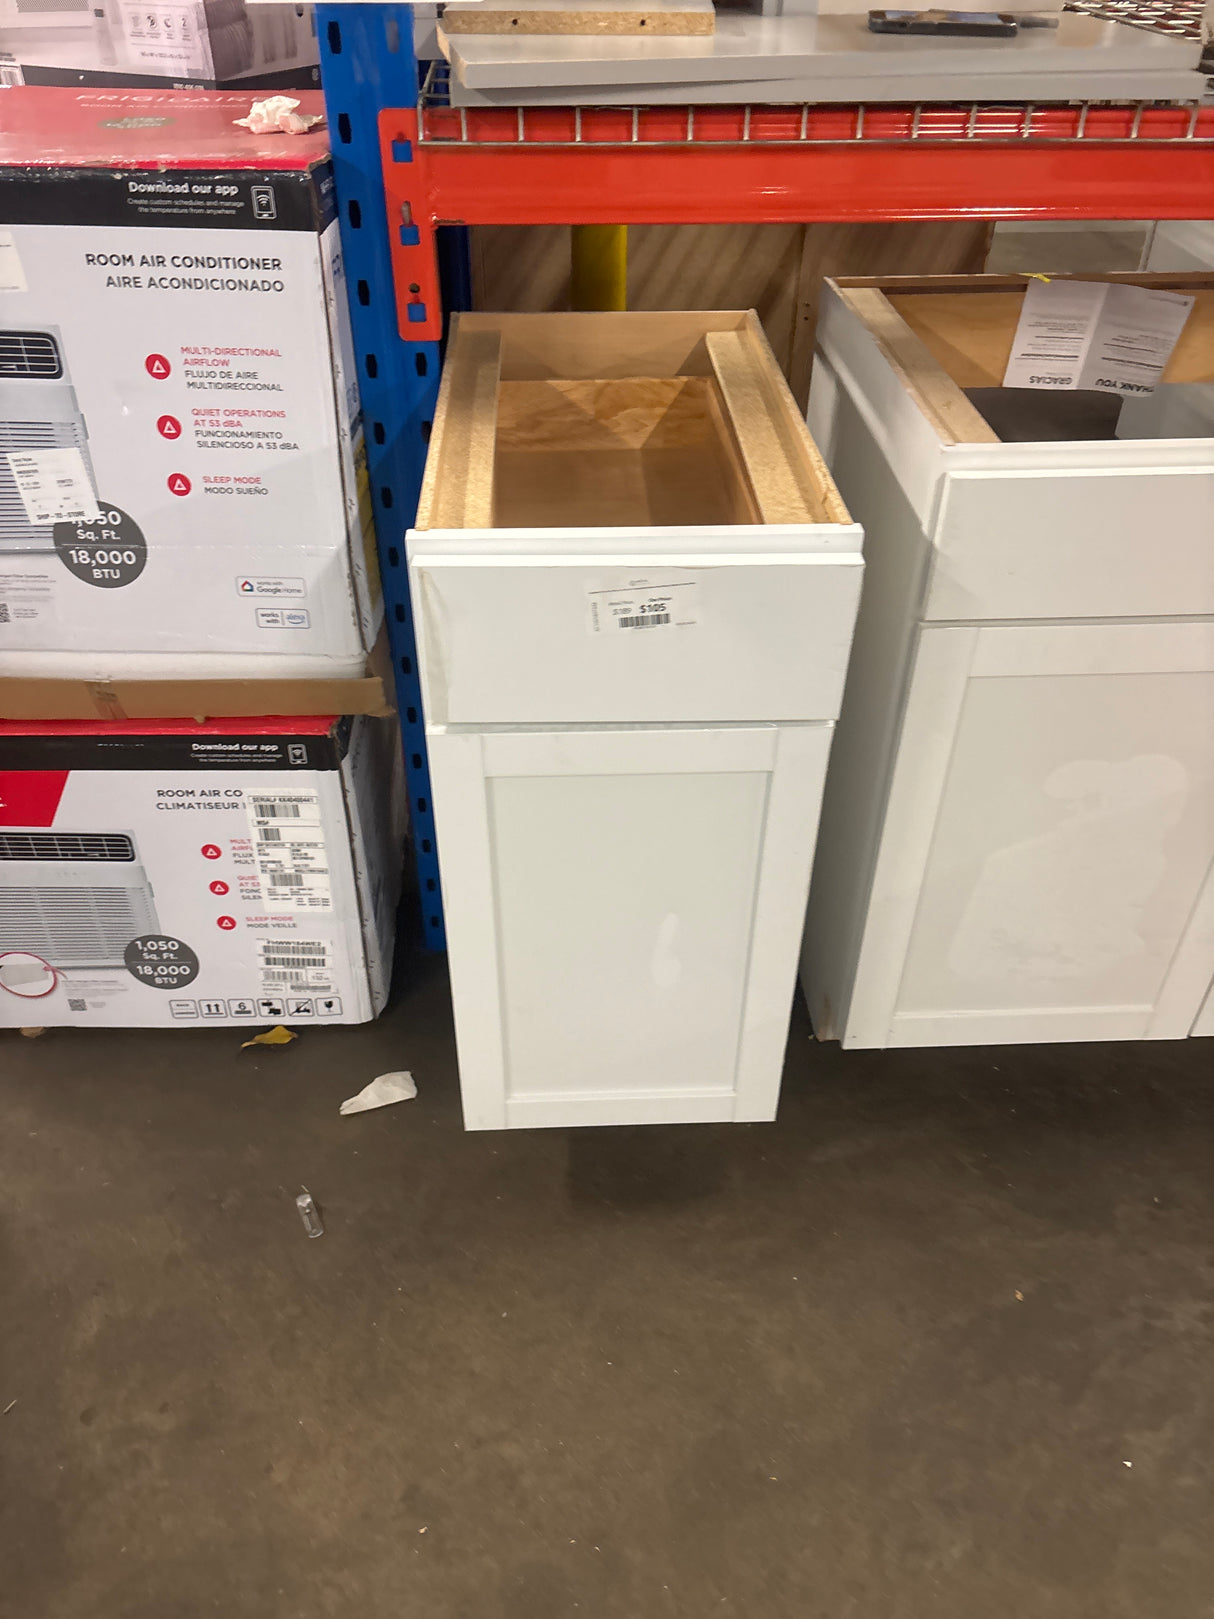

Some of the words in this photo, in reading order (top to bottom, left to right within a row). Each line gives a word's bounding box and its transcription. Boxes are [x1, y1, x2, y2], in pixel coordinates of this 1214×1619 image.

[128, 182, 190, 193] Download
[191, 185, 213, 193] our
[214, 185, 239, 196] app
[85, 254, 135, 266] ROOM
[140, 255, 167, 267] AIR
[171, 256, 283, 270] CONDITIONER
[106, 276, 143, 288] AIRE
[147, 277, 284, 292] ACONDICIONADO
[180, 347, 282, 357] MULTI-DIRECTIONAL
[185, 370, 217, 378] FLUJO
[1029, 375, 1073, 385] GRACIAS
[1095, 378, 1118, 388] YOU
[187, 382, 283, 391] MULTIDIRECCIONAL
[223, 409, 286, 418] OPERATIONS
[194, 431, 283, 439] FUNCIONAMIENTO
[196, 441, 254, 449] SILENCIOSO
[236, 487, 269, 495] SUEÑO
[76, 530, 99, 541] Sq.
[101, 530, 121, 540] Ft.
[68, 550, 136, 566] 18,000
[92, 569, 121, 579] BTU
[256, 586, 281, 594] Google
[135, 941, 179, 952] 1,050
[136, 966, 190, 976] 18,000
